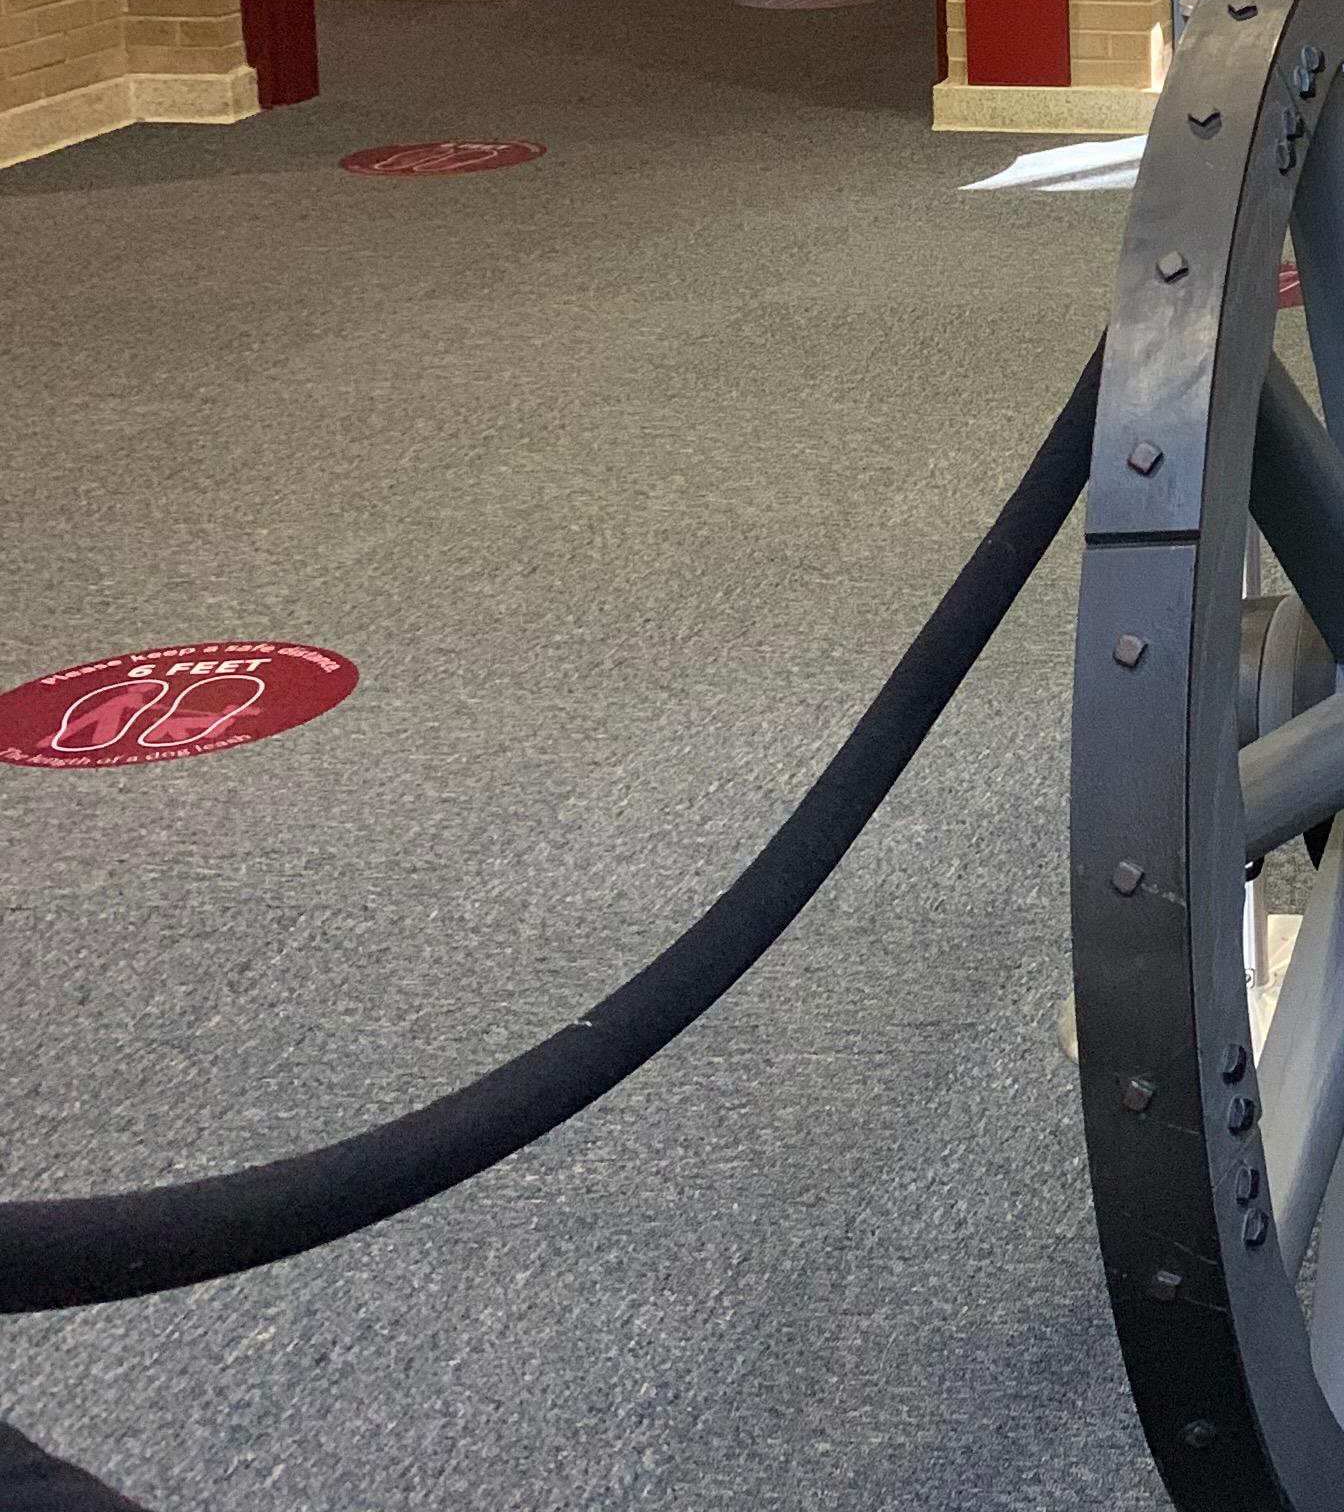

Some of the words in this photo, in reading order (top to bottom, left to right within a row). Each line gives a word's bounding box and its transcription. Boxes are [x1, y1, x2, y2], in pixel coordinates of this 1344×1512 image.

[40, 659, 122, 685] Please
[131, 647, 196, 663] keep
[203, 645, 219, 653] a
[224, 643, 276, 654] safe
[128, 664, 156, 678] 6
[166, 658, 272, 676] FEET
[97, 754, 124, 764] of
[145, 748, 191, 761] dog
[195, 734, 251, 752] leash
